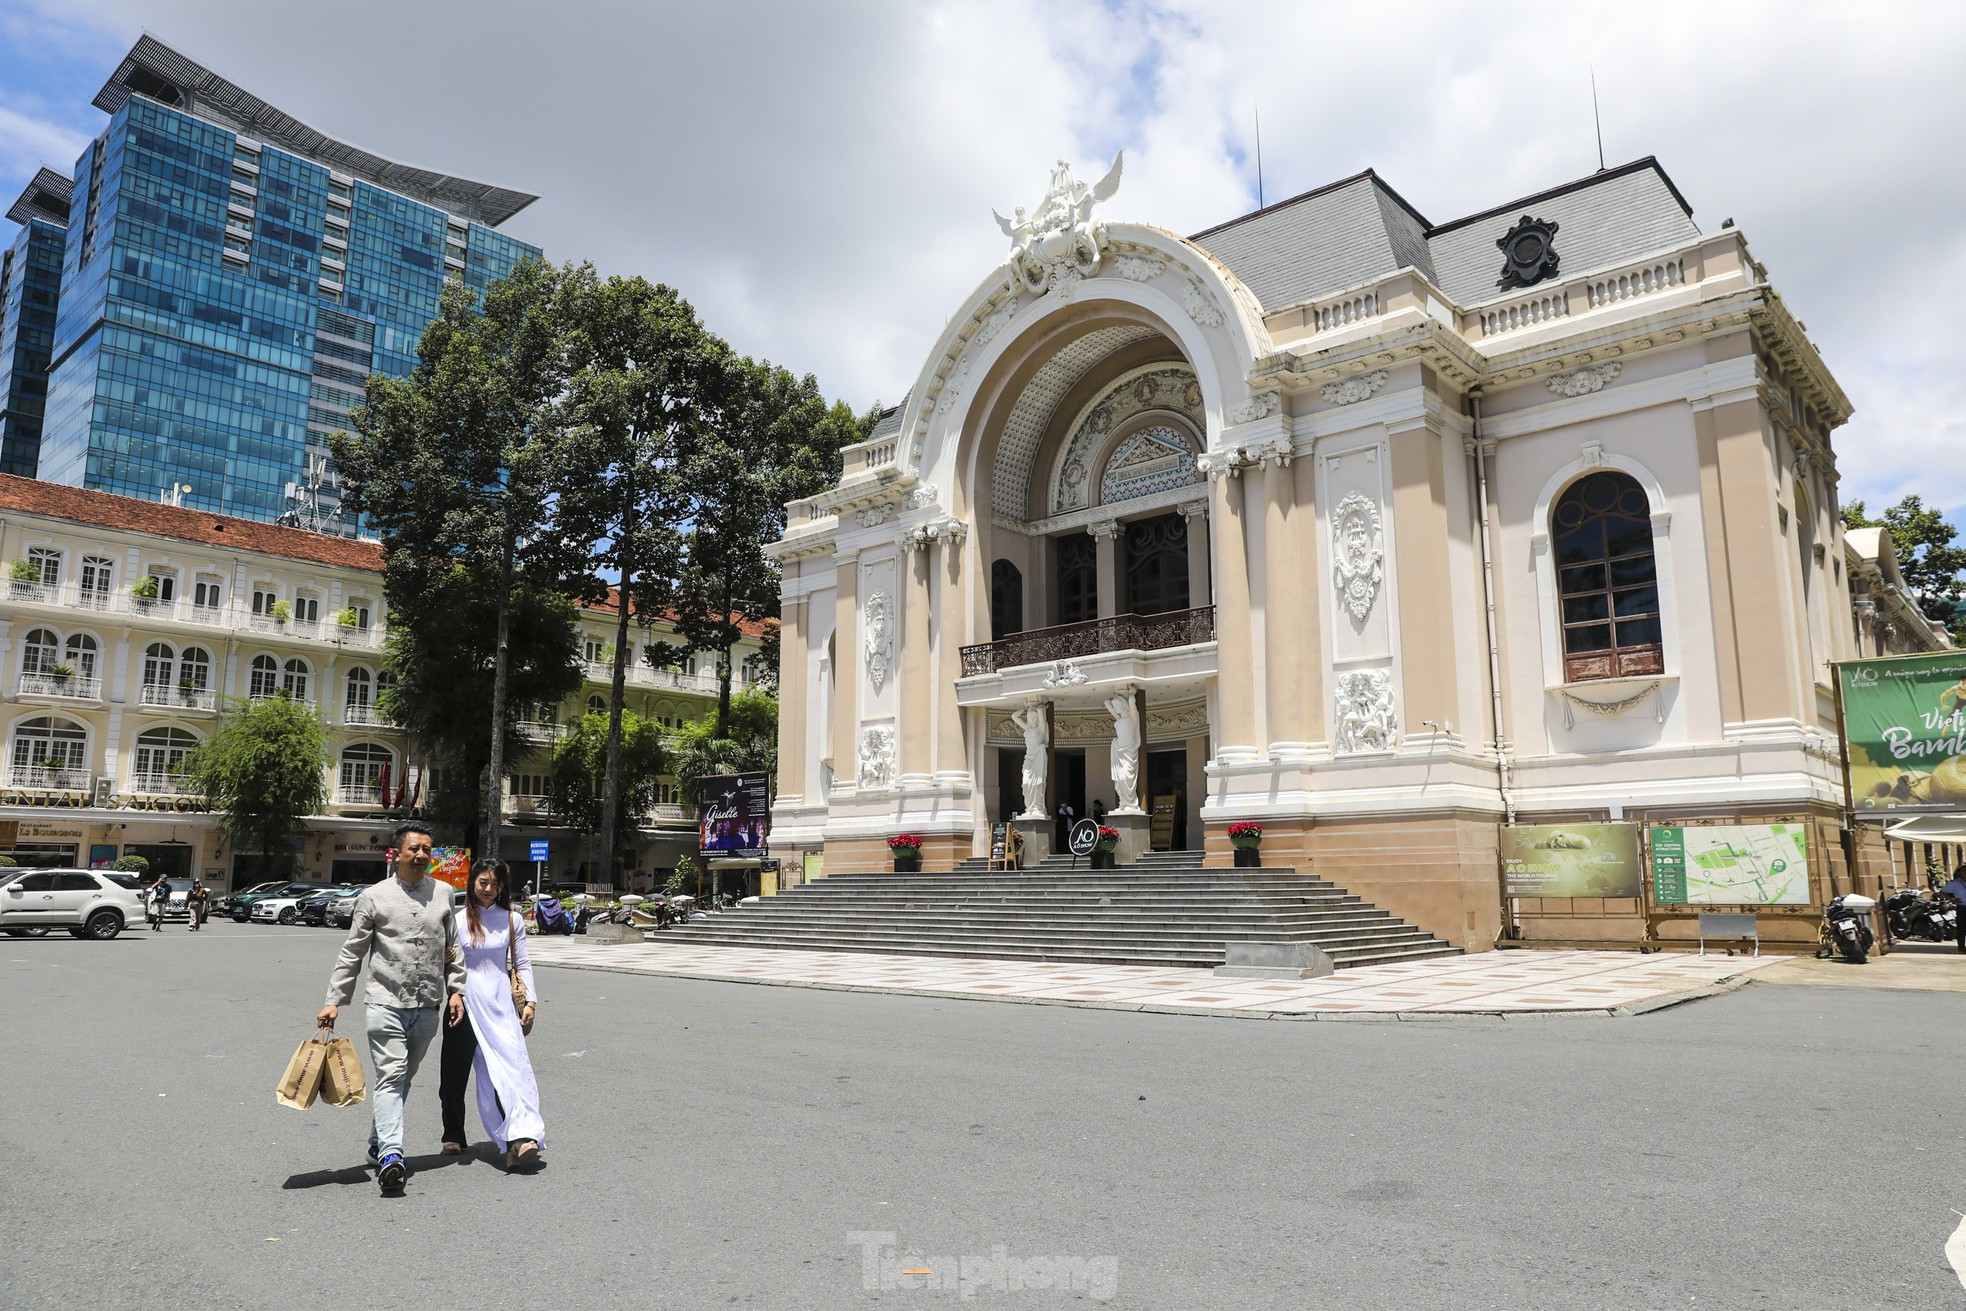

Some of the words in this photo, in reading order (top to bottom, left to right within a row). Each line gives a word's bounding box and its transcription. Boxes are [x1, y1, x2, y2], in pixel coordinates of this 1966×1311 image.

[107, 794, 212, 814] SAIGON
[706, 804, 738, 829] Giselle
[1527, 864, 1560, 873] SHOW
